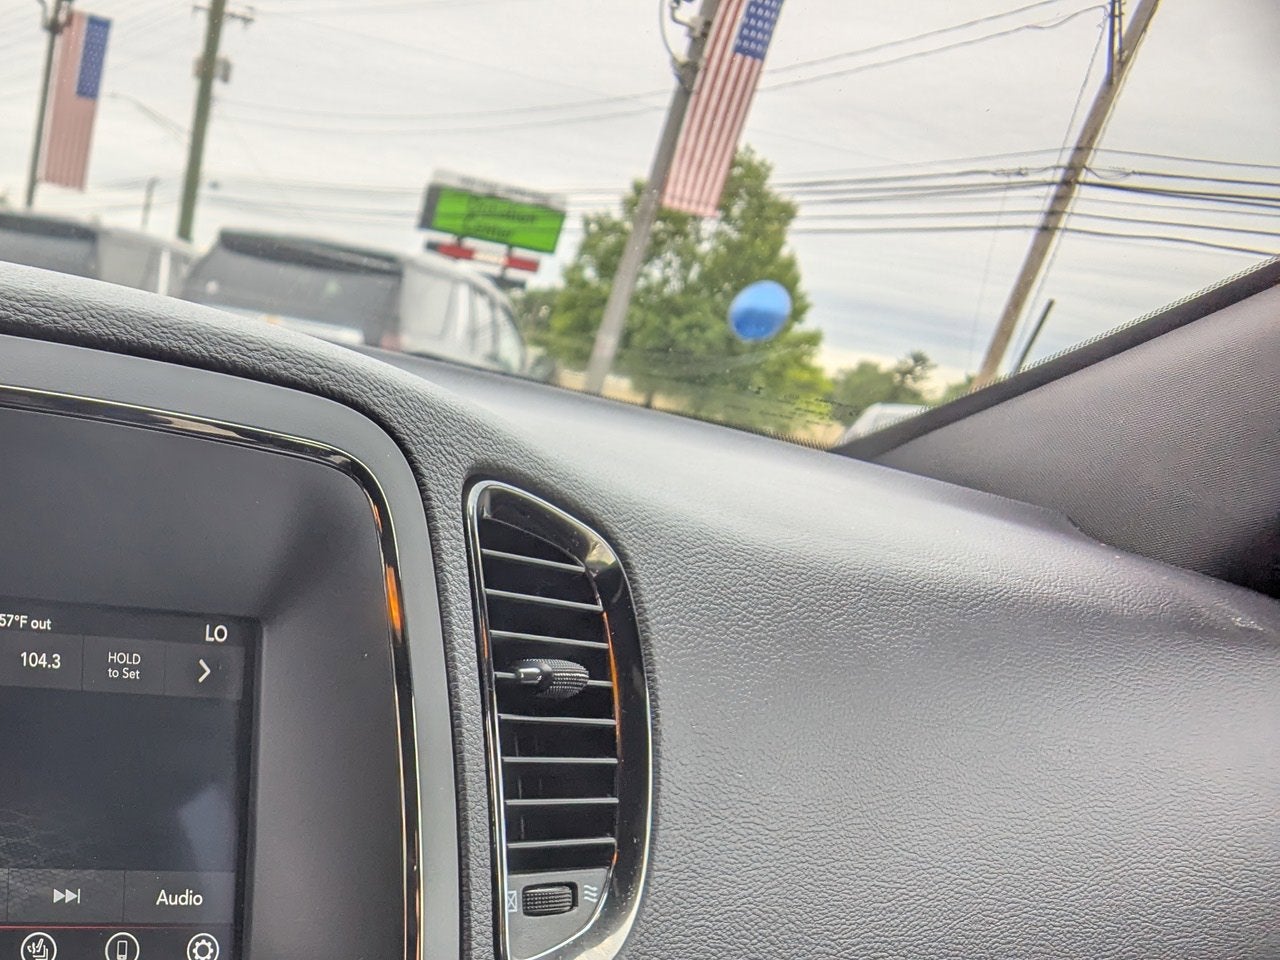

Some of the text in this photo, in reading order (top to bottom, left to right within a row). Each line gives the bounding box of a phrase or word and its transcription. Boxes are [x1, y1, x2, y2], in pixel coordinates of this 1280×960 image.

[30, 618, 52, 631] out
[205, 624, 228, 643] LO
[20, 651, 61, 669] 104.3
[108, 651, 141, 665] HOLD
[107, 667, 141, 680] to Set
[155, 888, 203, 906] Audio
